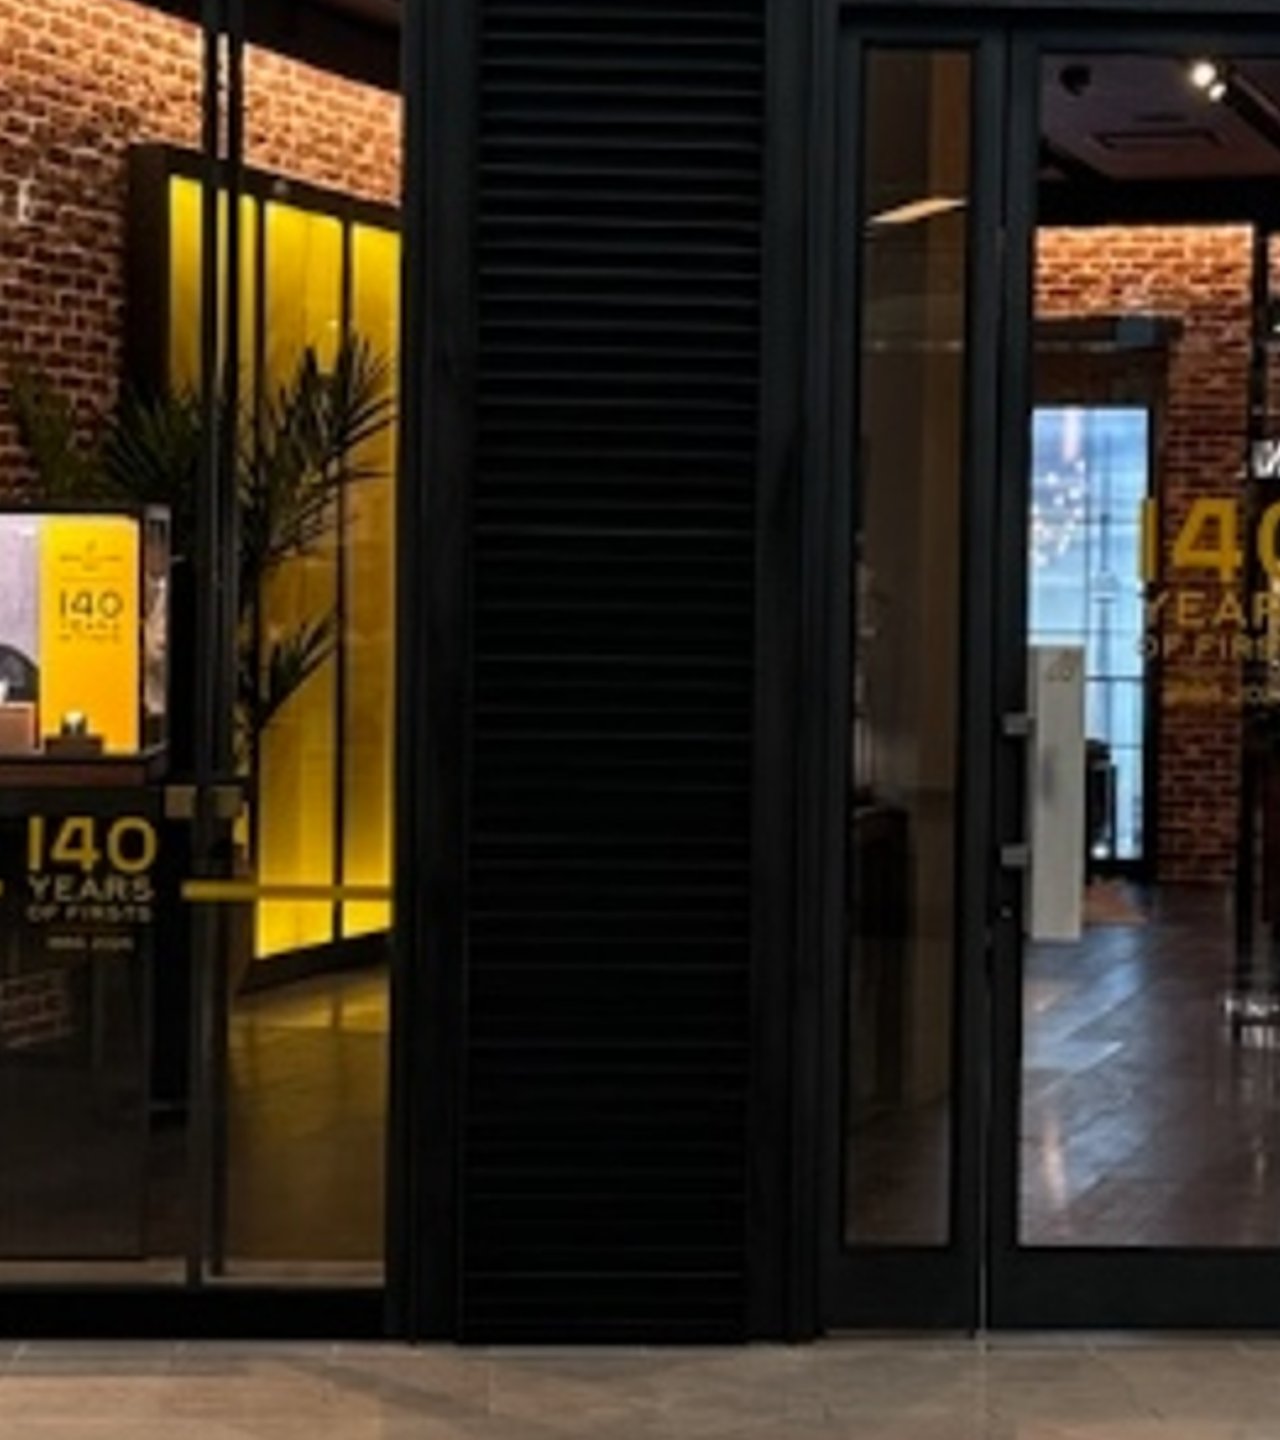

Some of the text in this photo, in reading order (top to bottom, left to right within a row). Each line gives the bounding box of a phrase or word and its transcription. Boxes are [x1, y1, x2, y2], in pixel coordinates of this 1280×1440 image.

[60, 589, 124, 619] 140
[28, 815, 157, 873] 140
[27, 874, 156, 902] YEARS
